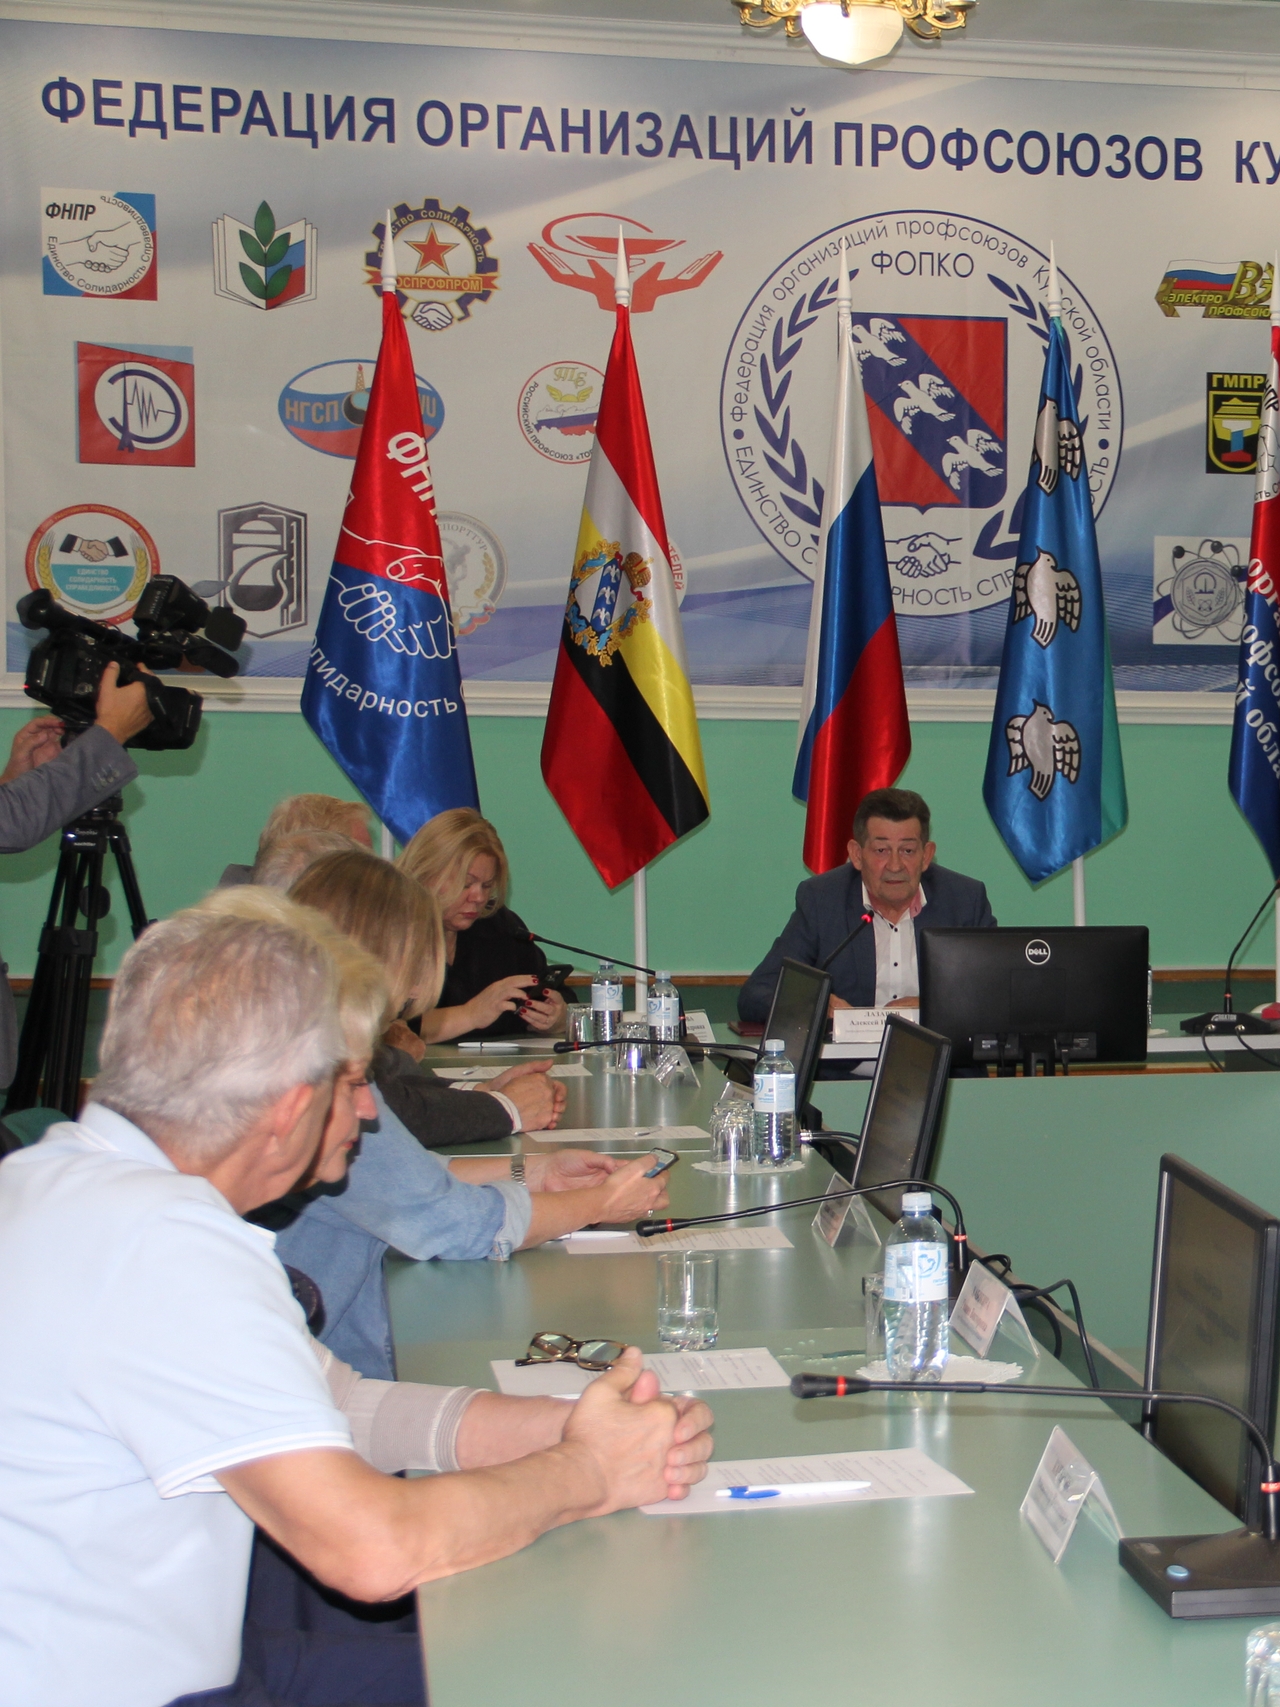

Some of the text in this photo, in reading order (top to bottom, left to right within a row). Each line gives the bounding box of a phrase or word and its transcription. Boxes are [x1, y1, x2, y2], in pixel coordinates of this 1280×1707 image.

[42, 76, 395, 148] ФЕДЕРАЦИЯ
[416, 100, 813, 170] ОРГАНИЗАЦИЙ
[834, 121, 1204, 181] ПРОФСОЮЗОВ
[45, 202, 96, 221] ФНПР
[47, 195, 154, 294] Единство Солидарность Справедливость
[421, 209, 485, 263] СОЛИДАРНОСТЬ
[871, 250, 975, 279] ФОПКО
[396, 276, 480, 291] ОСПРОФПРОМ
[729, 217, 1111, 431] Федерация организаций профсоюзов Куской области
[1208, 306, 1271, 318] ПРОФСОЮ
[1212, 374, 1266, 389] ГМПР
[285, 397, 339, 422] НГСП
[522, 381, 539, 435] РОССИЙСКИЙ
[530, 435, 574, 461] ПРОФСОЮЗ
[735, 445, 802, 548] ЕДИНСТВО
[310, 635, 458, 719] олидарность
[1028, 948, 1048, 956] DELL
